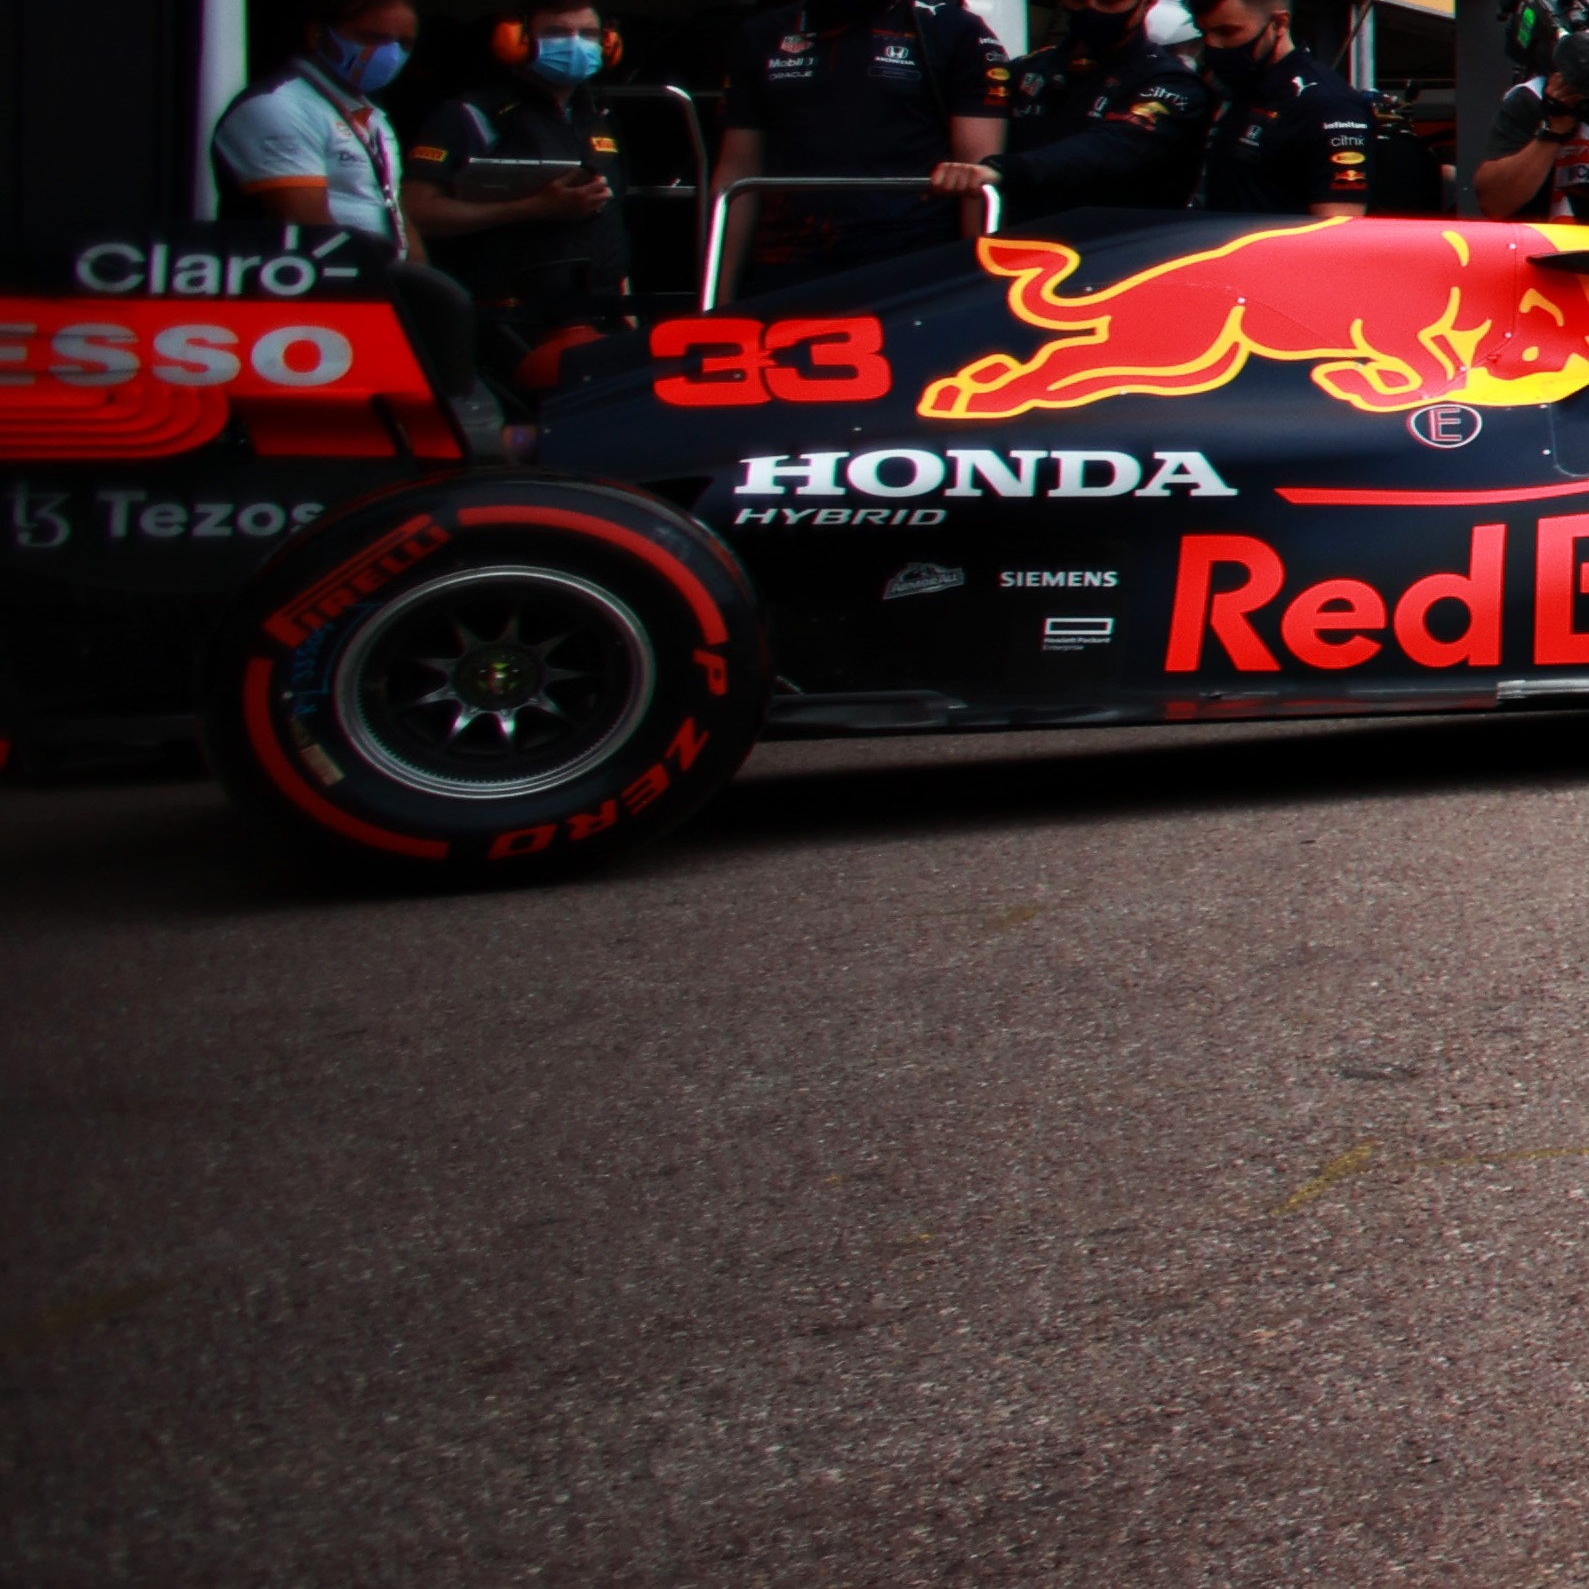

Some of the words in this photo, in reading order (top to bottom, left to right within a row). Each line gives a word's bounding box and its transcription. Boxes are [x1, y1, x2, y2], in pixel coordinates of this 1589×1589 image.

[77, 242, 316, 296] Claro
[651, 317, 892, 406] 33
[733, 448, 1238, 497] HONDA
[733, 508, 947, 526] HYBRID
[261, 514, 452, 648] PIRELLI
[1000, 571, 1118, 587] SIEMENS
[1165, 524, 1506, 672] Red
[694, 650, 728, 696] P
[488, 716, 710, 860] ZERO
